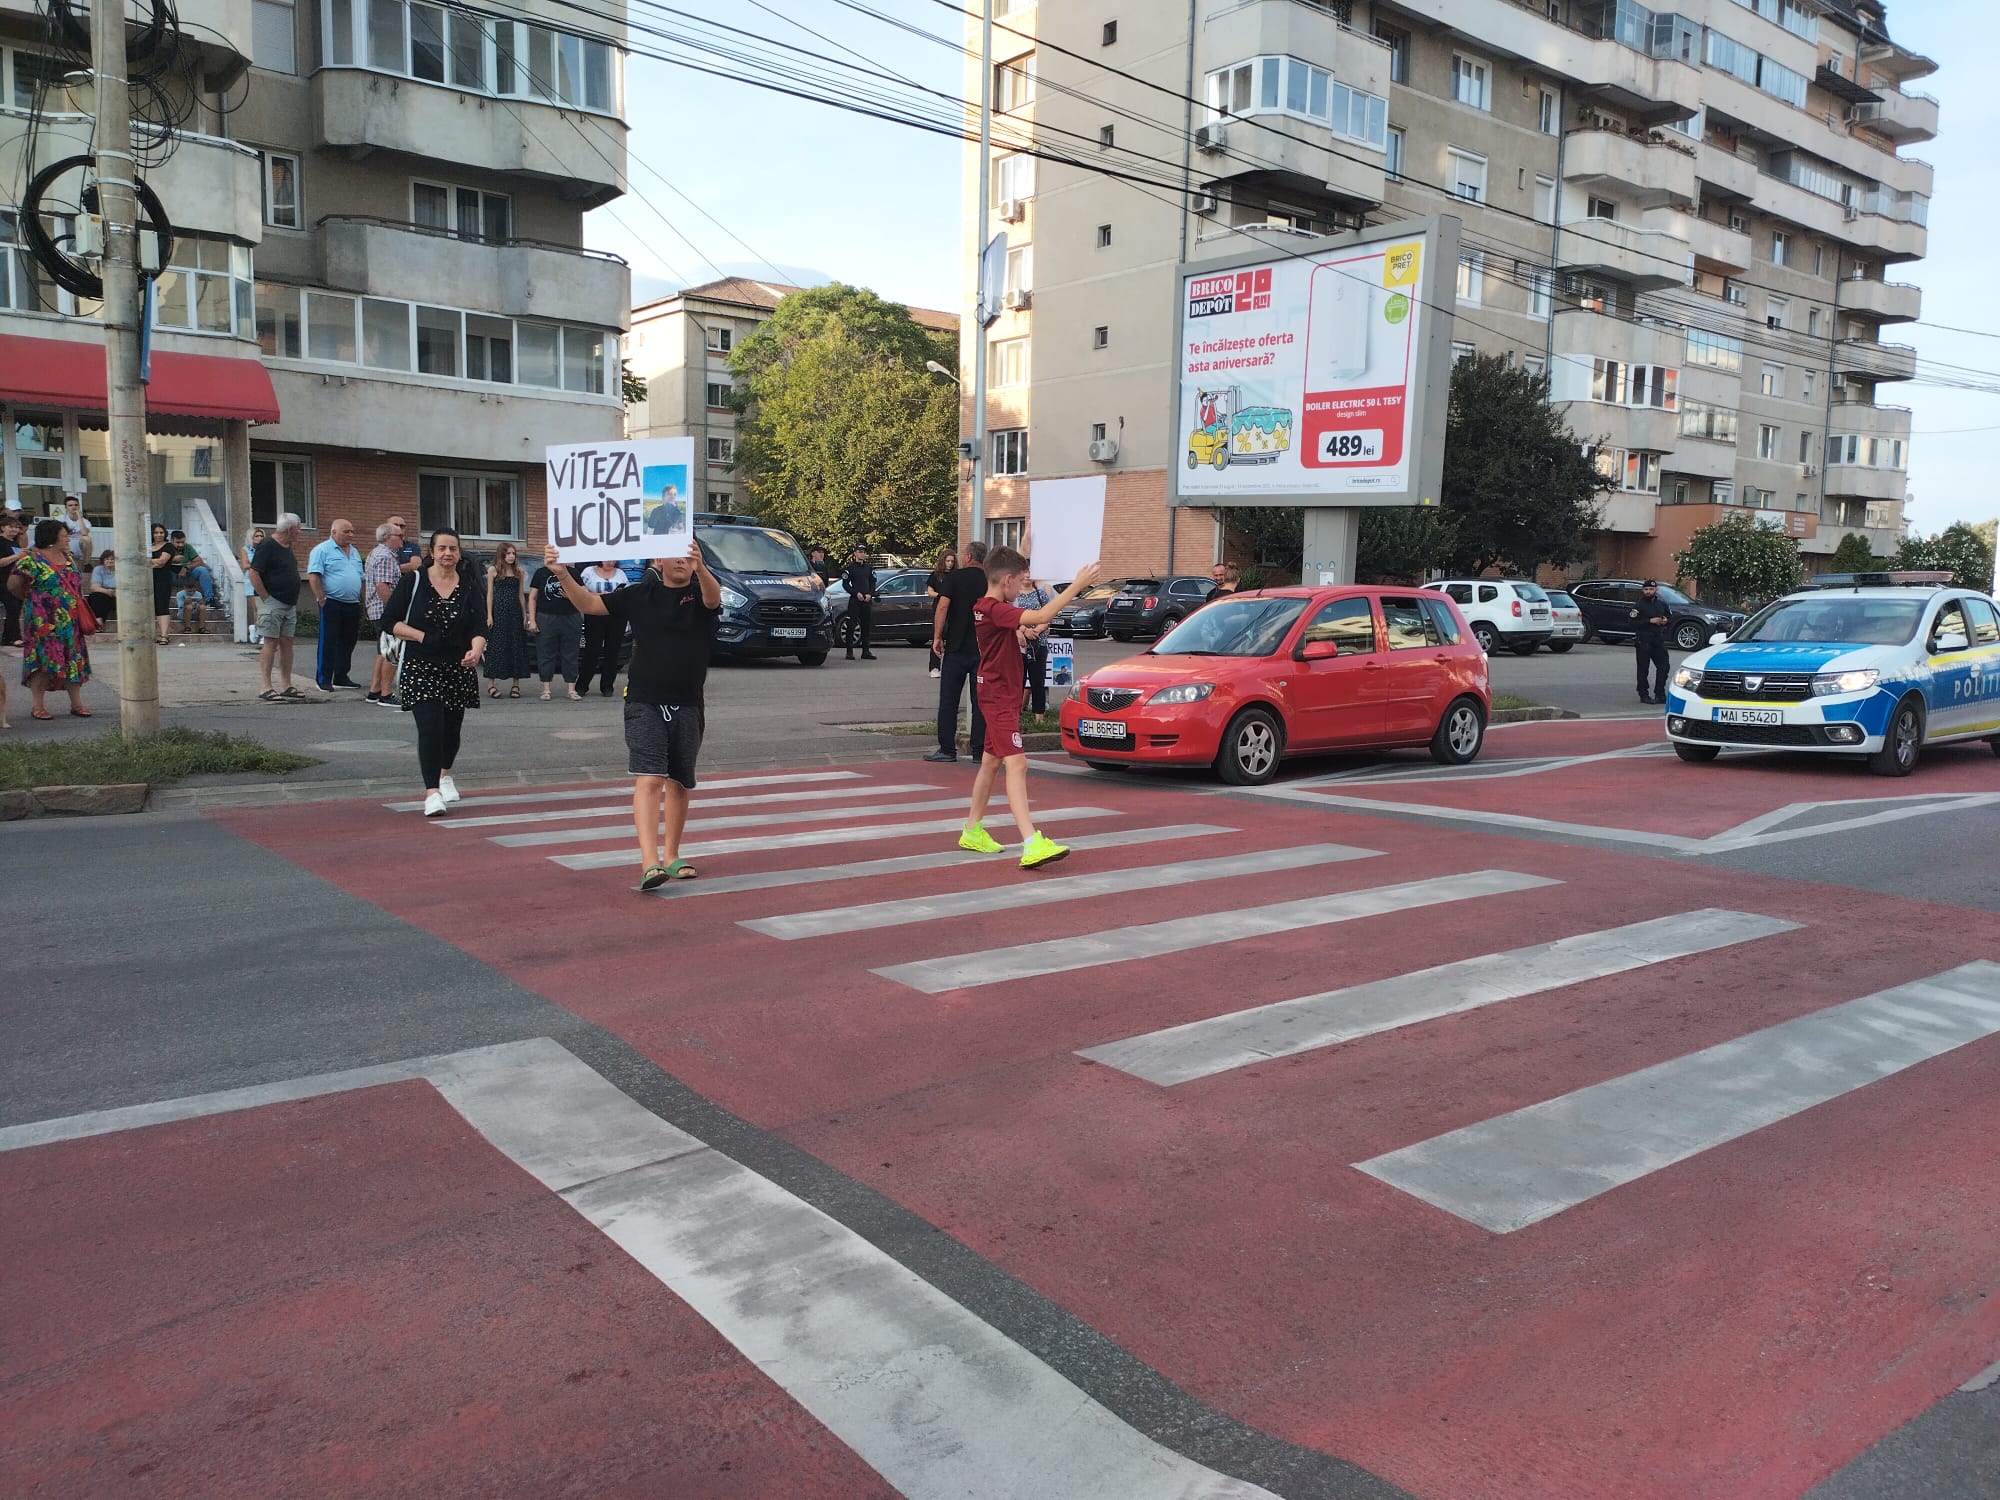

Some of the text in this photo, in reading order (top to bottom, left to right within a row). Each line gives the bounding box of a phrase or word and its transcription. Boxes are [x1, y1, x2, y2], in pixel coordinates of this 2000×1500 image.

[1391, 253, 1412, 263] BRICO
[1191, 279, 1233, 297] BRICO
[1190, 294, 1231, 316] DEPÔT
[1189, 343, 1200, 355] Te
[1258, 332, 1294, 348] oferta
[1188, 352, 1276, 373] asta aniversară?
[1305, 396, 1402, 411] BOILER ELECTRIC 50 L TESY
[1326, 435, 1375, 457] 489 lei
[1720, 709, 1778, 724] MAI 55420
[1083, 721, 1094, 733] BH
